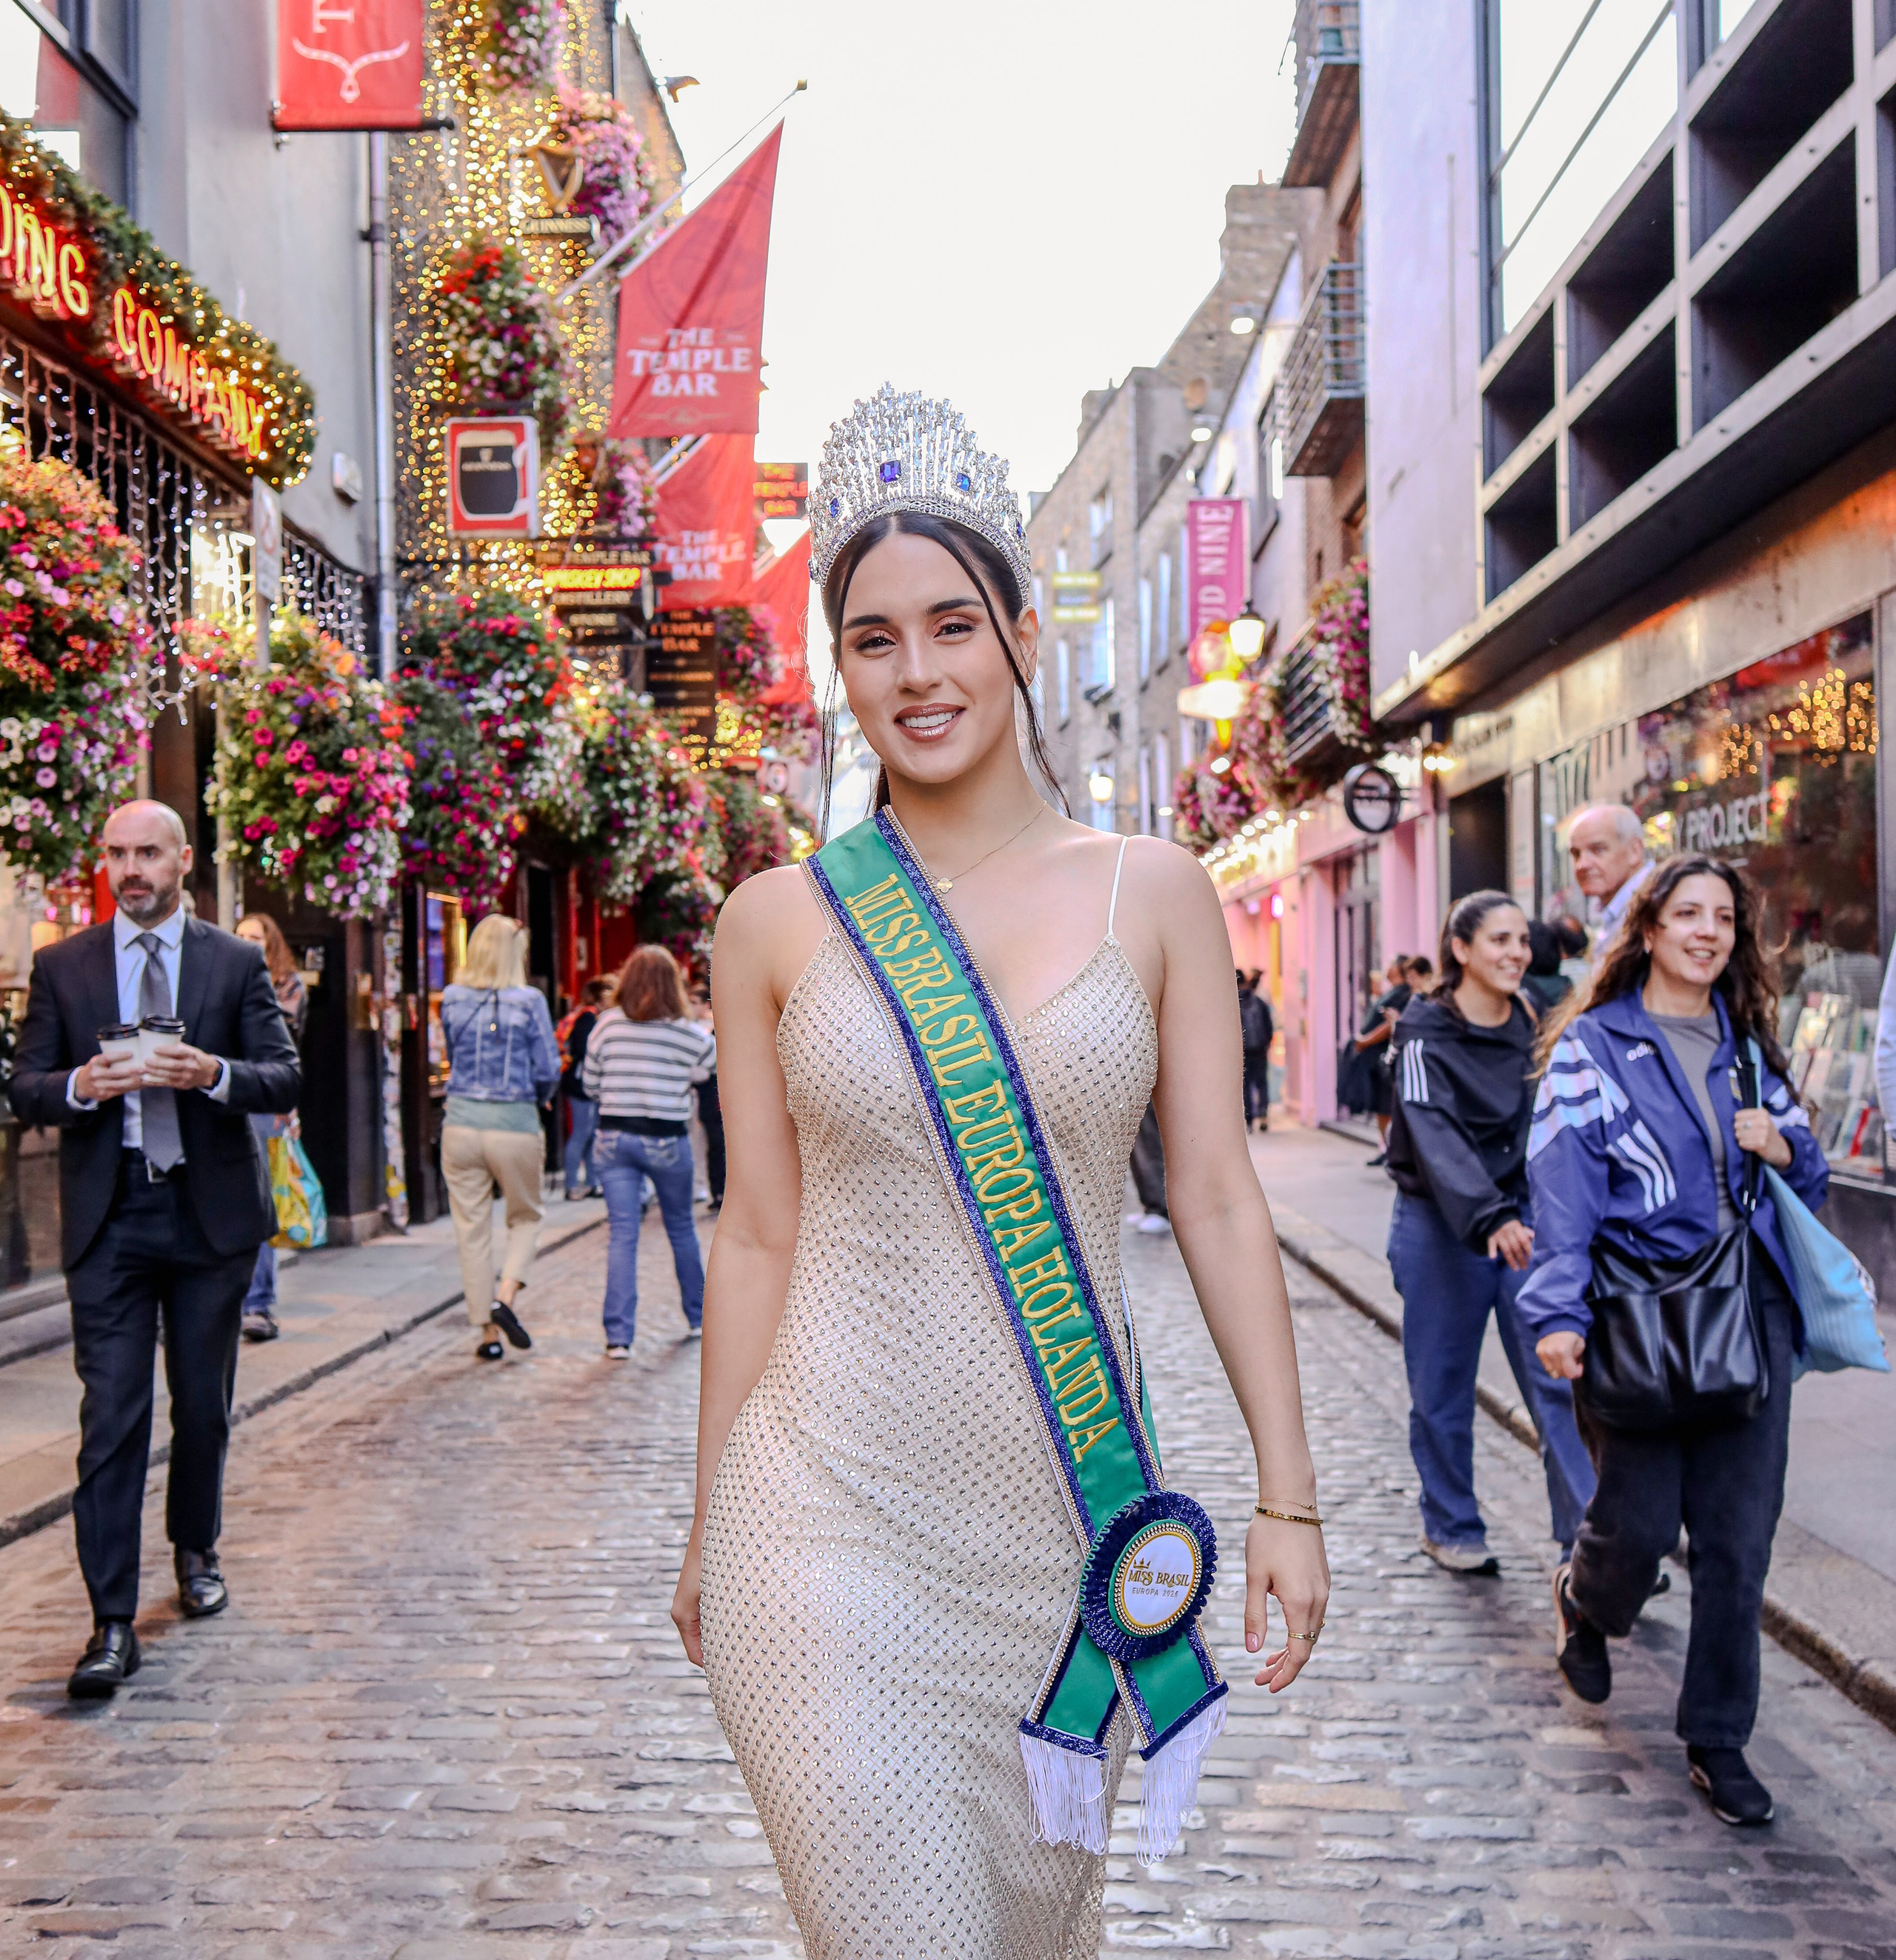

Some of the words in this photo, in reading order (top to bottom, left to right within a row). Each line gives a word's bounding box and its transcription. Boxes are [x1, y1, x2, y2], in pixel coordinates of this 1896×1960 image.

[667, 327, 714, 349] THE
[115, 288, 264, 457] COMPANY
[627, 347, 752, 377] TEMPLE
[652, 372, 719, 397] BAR
[652, 541, 747, 564] TEMPLE
[681, 529, 718, 546] THE
[1195, 505, 1235, 576] NINE
[672, 562, 723, 581] BAR
[1686, 792, 1769, 852] PROJECT
[844, 873, 931, 956] MISS
[883, 947, 994, 1087] BRASIL
[944, 1079, 1051, 1264] EUROPA
[1008, 1245, 1119, 1464] HOLANDA
[1127, 1570, 1154, 1586] MISS
[1155, 1572, 1190, 1587] BRASIL
[1132, 1587, 1159, 1596] EUROPA
